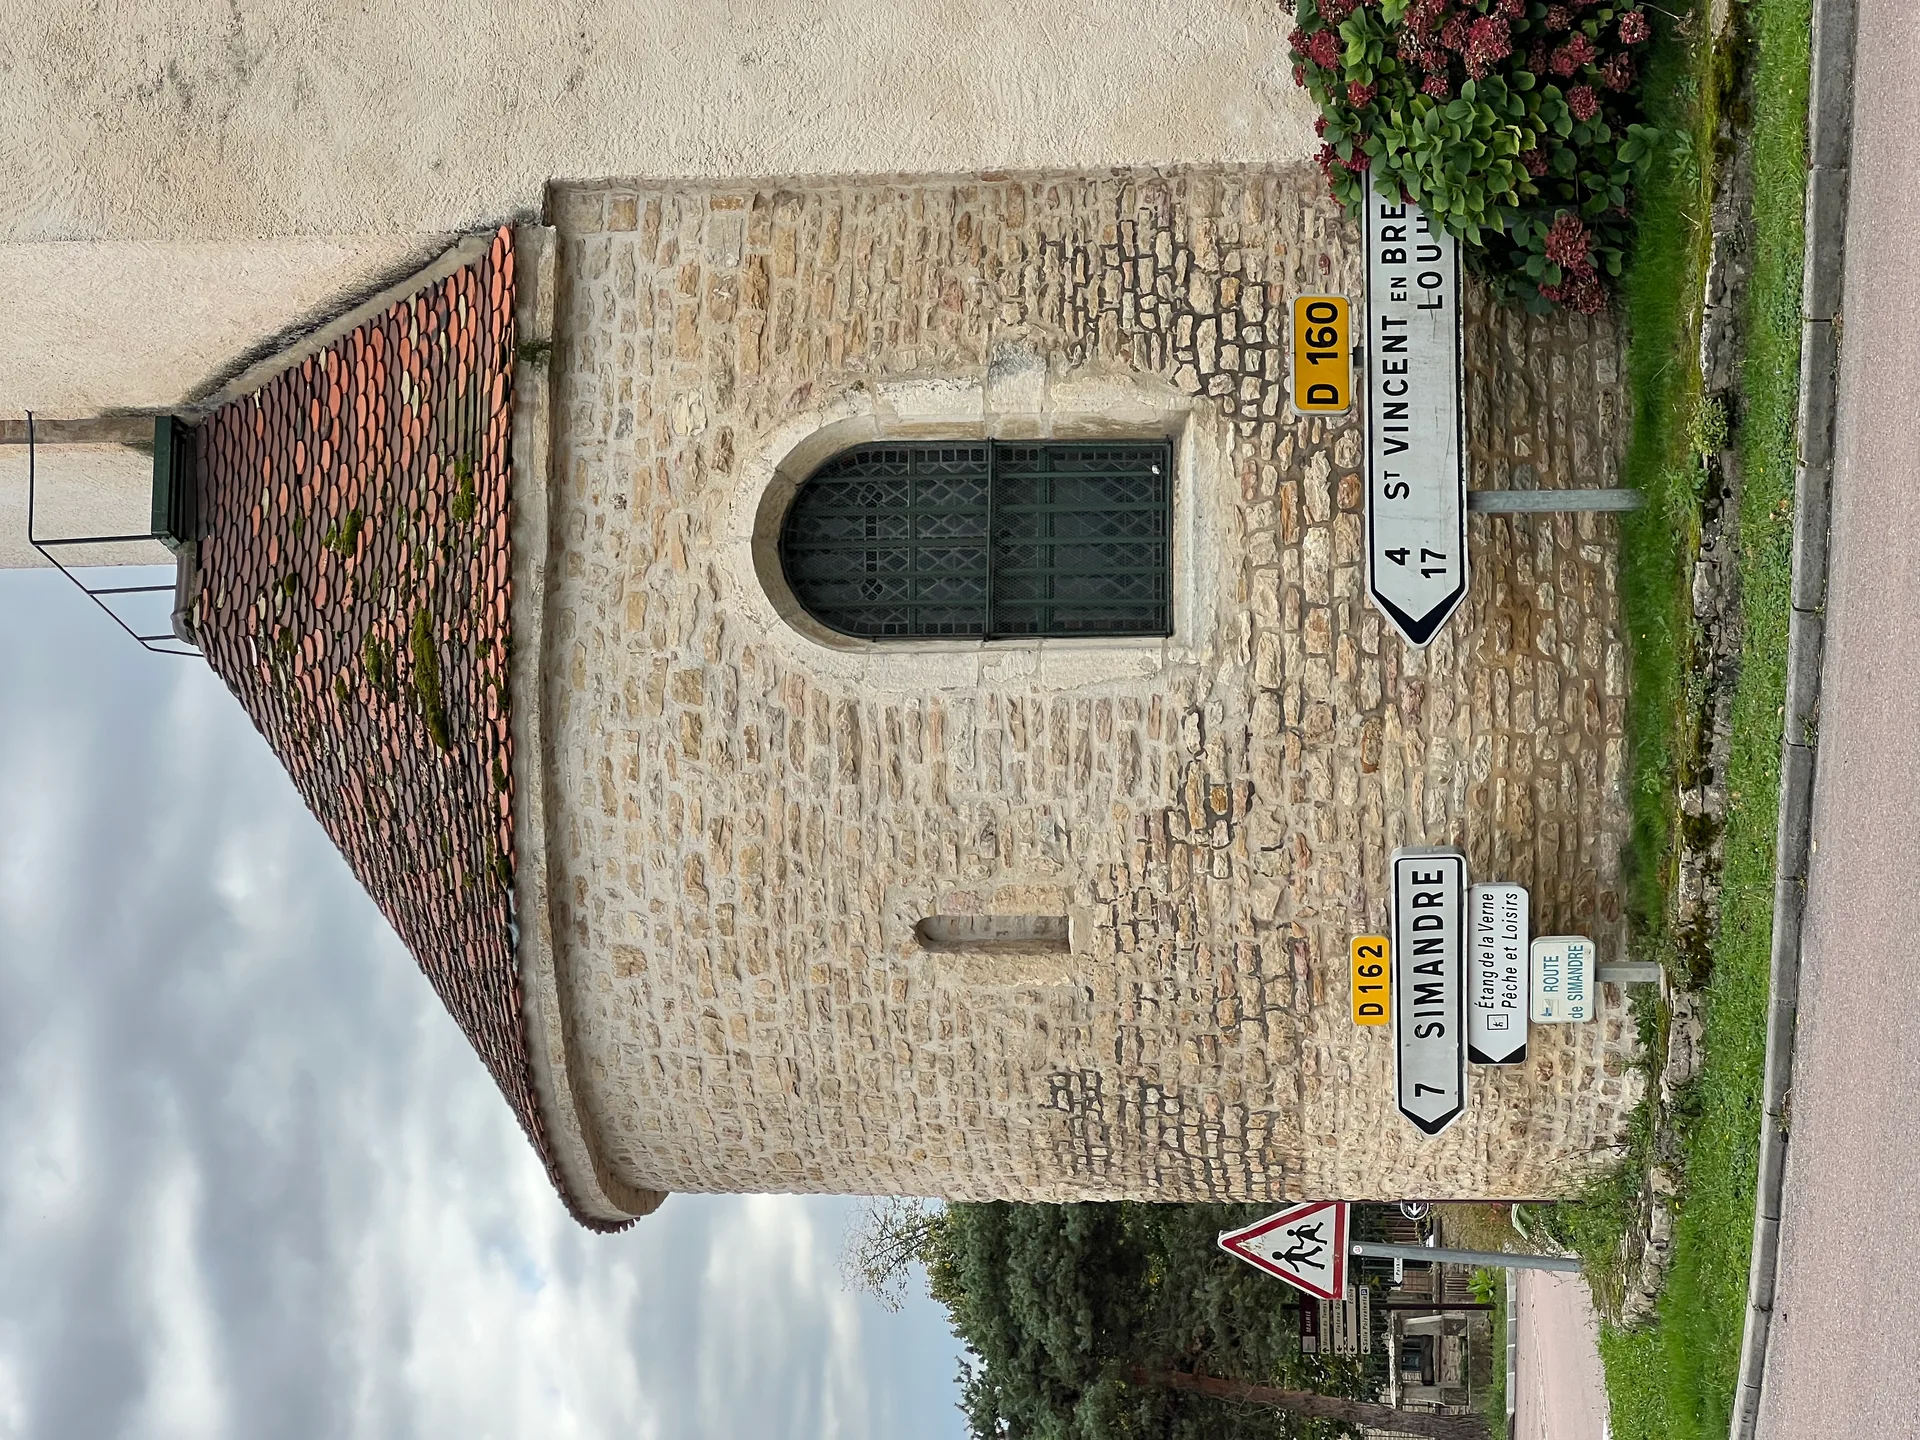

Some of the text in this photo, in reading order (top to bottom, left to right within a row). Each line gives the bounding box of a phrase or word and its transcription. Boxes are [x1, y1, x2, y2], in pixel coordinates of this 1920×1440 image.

[1380, 195, 1408, 265] BRE
[1390, 276, 1408, 302] EN
[1305, 301, 1339, 406] D 160
[1381, 314, 1410, 457] VINCENT
[1384, 547, 1411, 566] 4
[1420, 547, 1447, 579] 17
[1357, 944, 1384, 1016] D 162
[1412, 869, 1445, 1098] 7 SIMANDRE
[1474, 893, 1499, 1009] Étang de la Verne
[1501, 892, 1518, 1009] Pêche et Loisirs
[1543, 956, 1559, 992] ROUTE
[1567, 945, 1584, 1019] de SIMANDRE
[1361, 1296, 1369, 1330] Polyvalente
